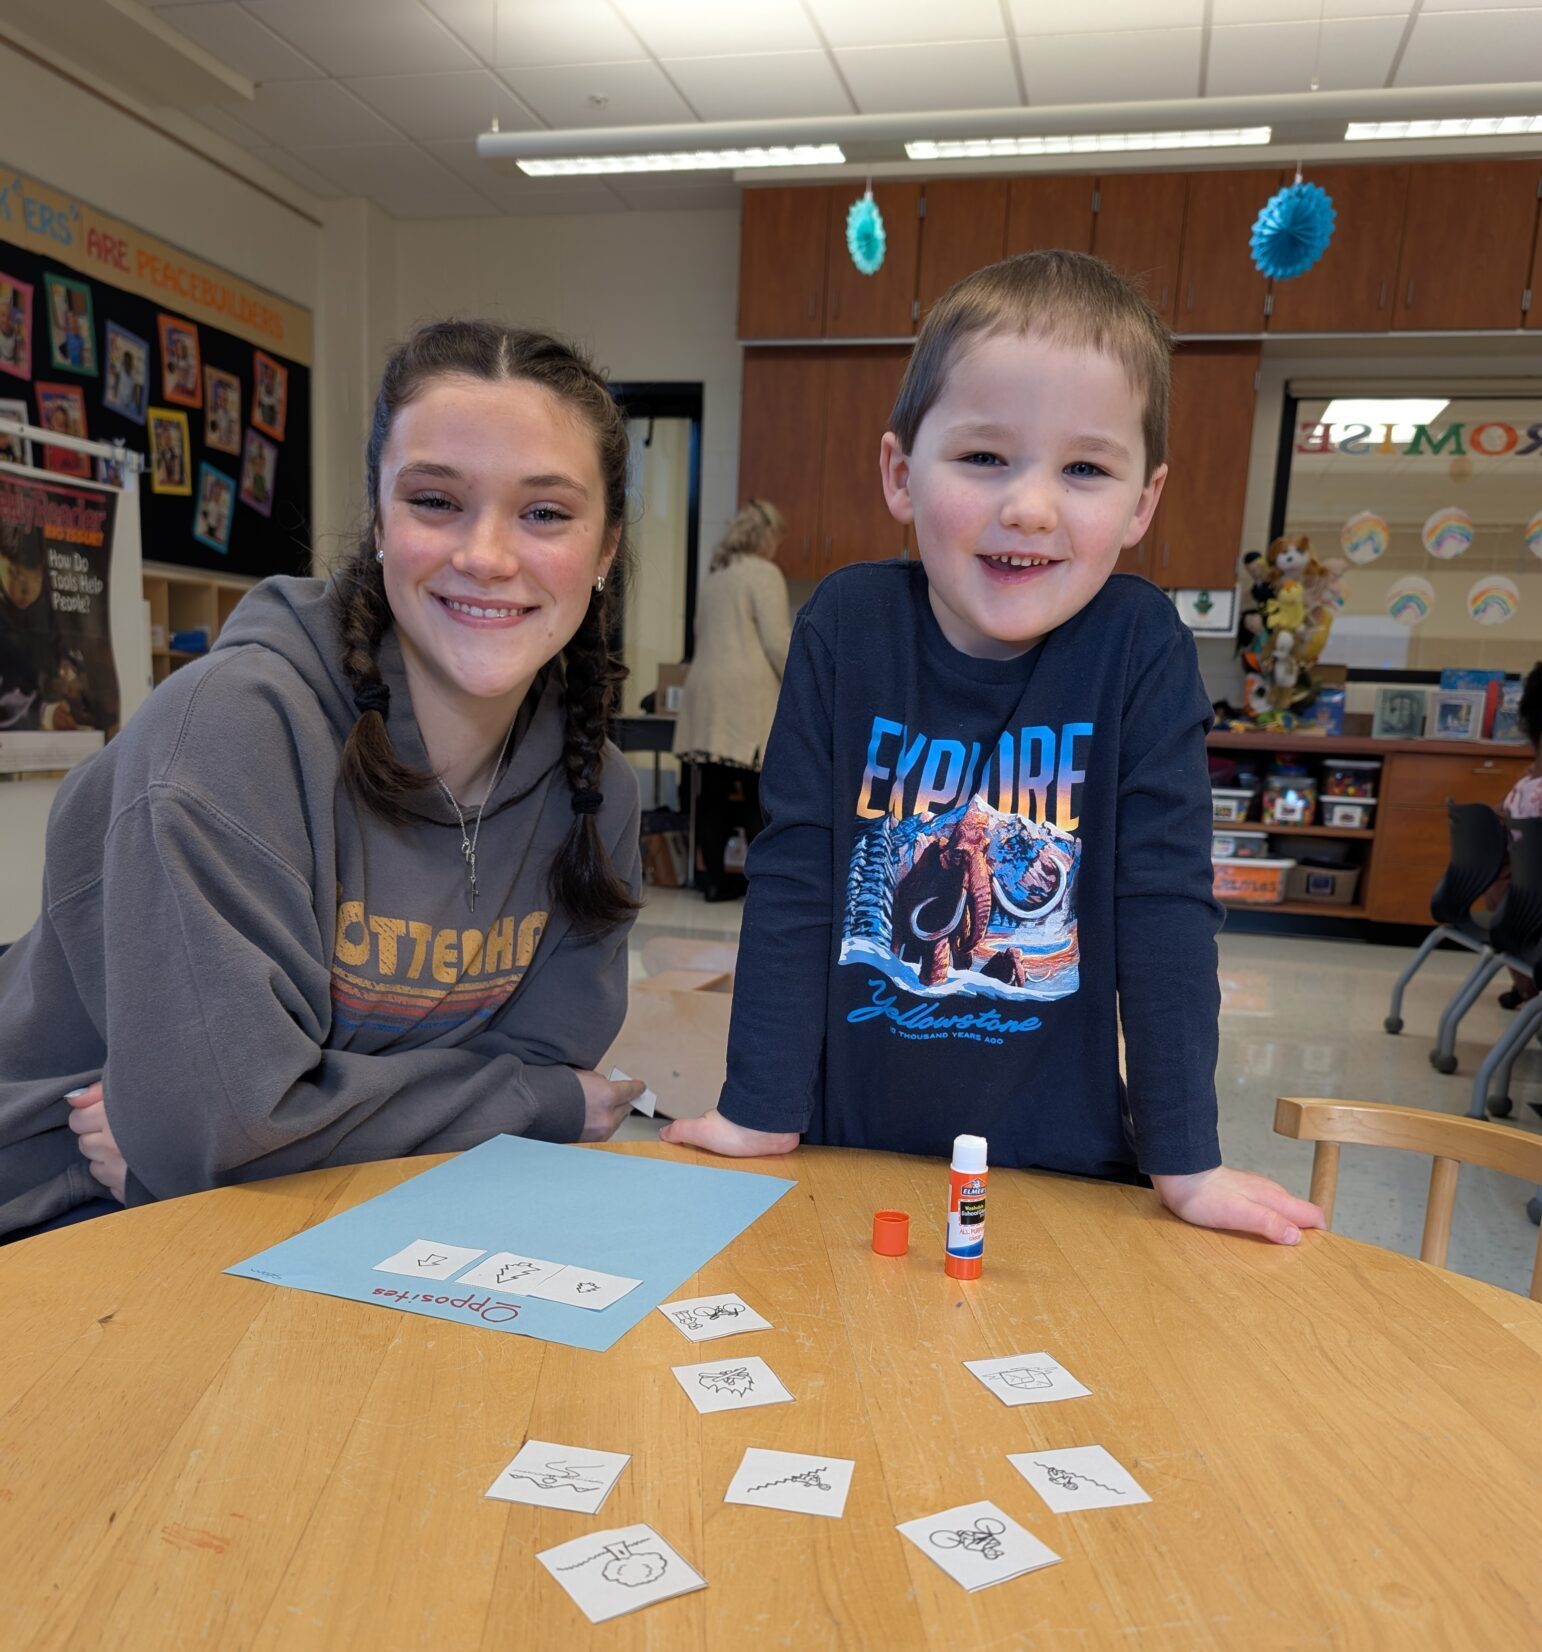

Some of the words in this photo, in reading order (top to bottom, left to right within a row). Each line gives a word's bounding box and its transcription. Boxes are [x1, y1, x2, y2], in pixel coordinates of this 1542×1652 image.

[86, 227, 131, 273] ARE
[135, 249, 285, 340] PEACEBUILDERS
[49, 548, 72, 569] How
[74, 552, 89, 572] Do
[50, 571, 78, 592] Tools
[80, 574, 104, 595] Help
[51, 592, 91, 614] People?
[854, 716, 1095, 832] EXPLORE
[847, 977, 1042, 1033] Yellowstone
[899, 1031, 948, 1041] THOUSAND
[952, 1031, 982, 1042] YEARS
[984, 1036, 1004, 1045] AGO
[371, 1287, 520, 1323] Opposites
